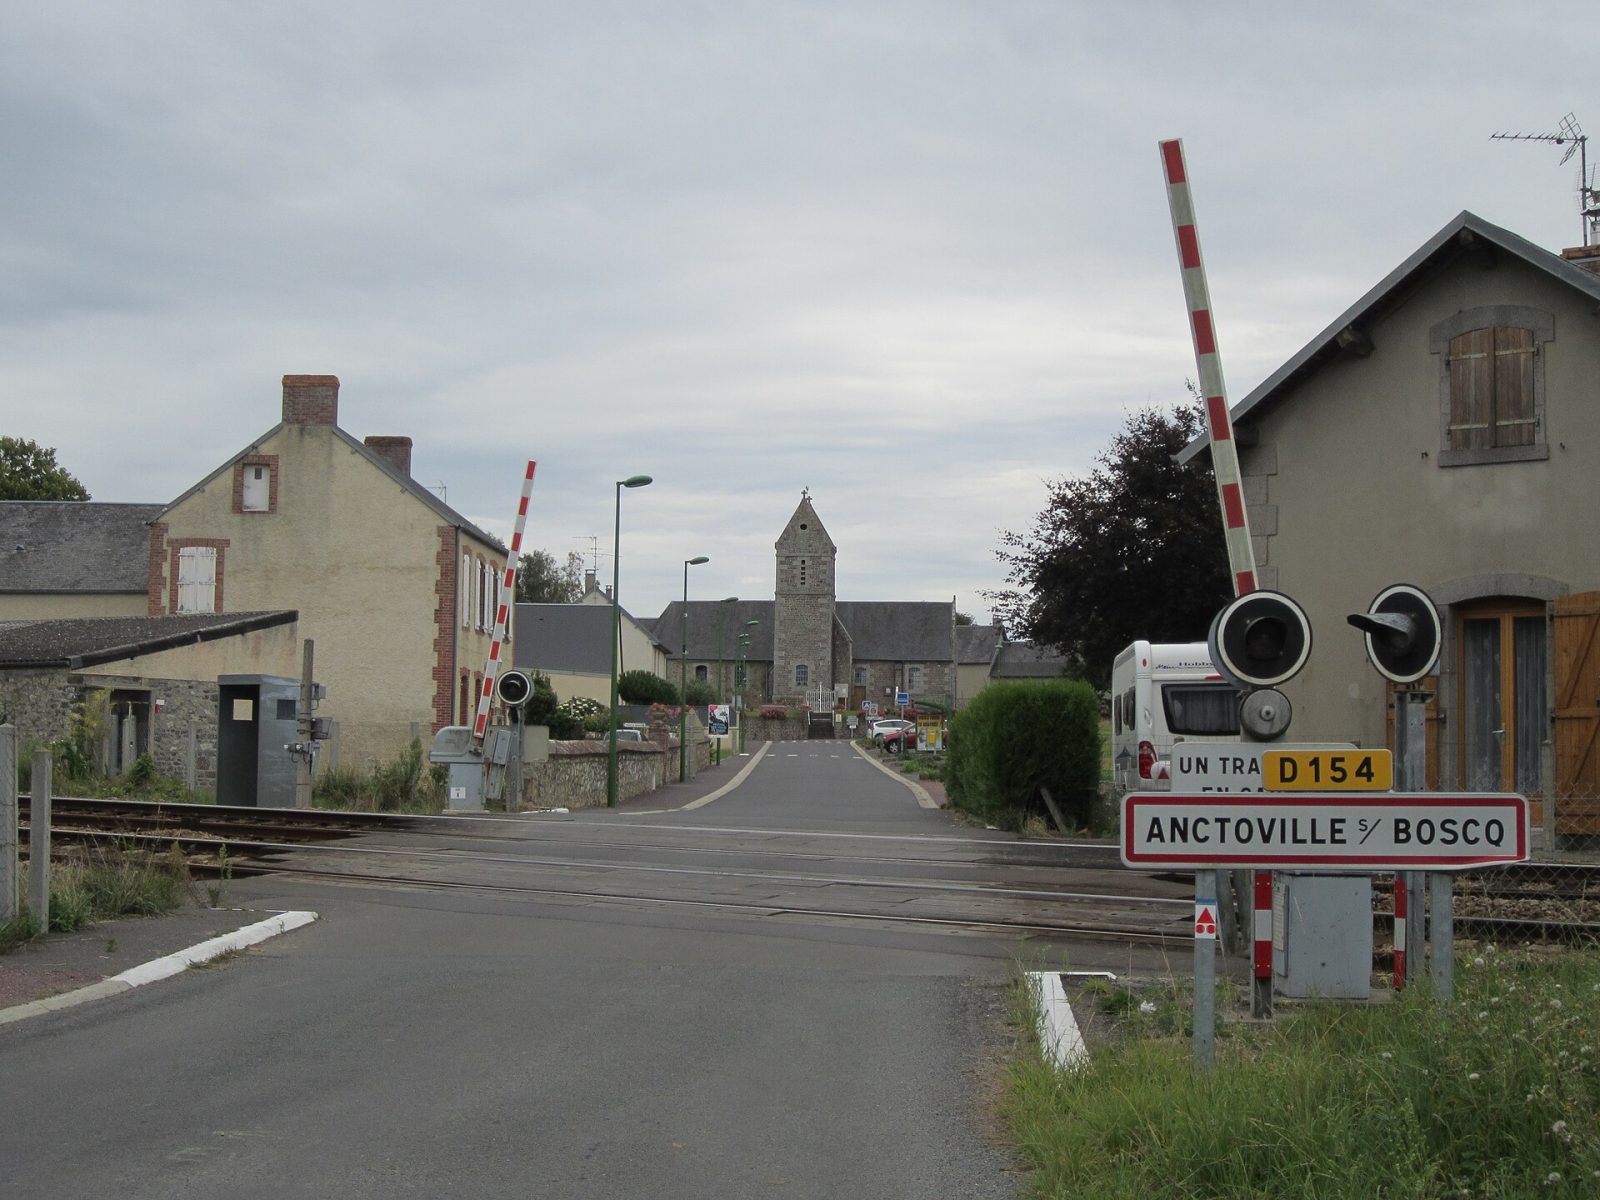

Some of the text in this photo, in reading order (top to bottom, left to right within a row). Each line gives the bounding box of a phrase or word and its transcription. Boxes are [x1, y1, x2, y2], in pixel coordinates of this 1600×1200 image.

[1179, 757, 1261, 775] UN TRA
[1145, 816, 1348, 845] ANCTOVILLE
[1393, 817, 1505, 848] BOSCQ
